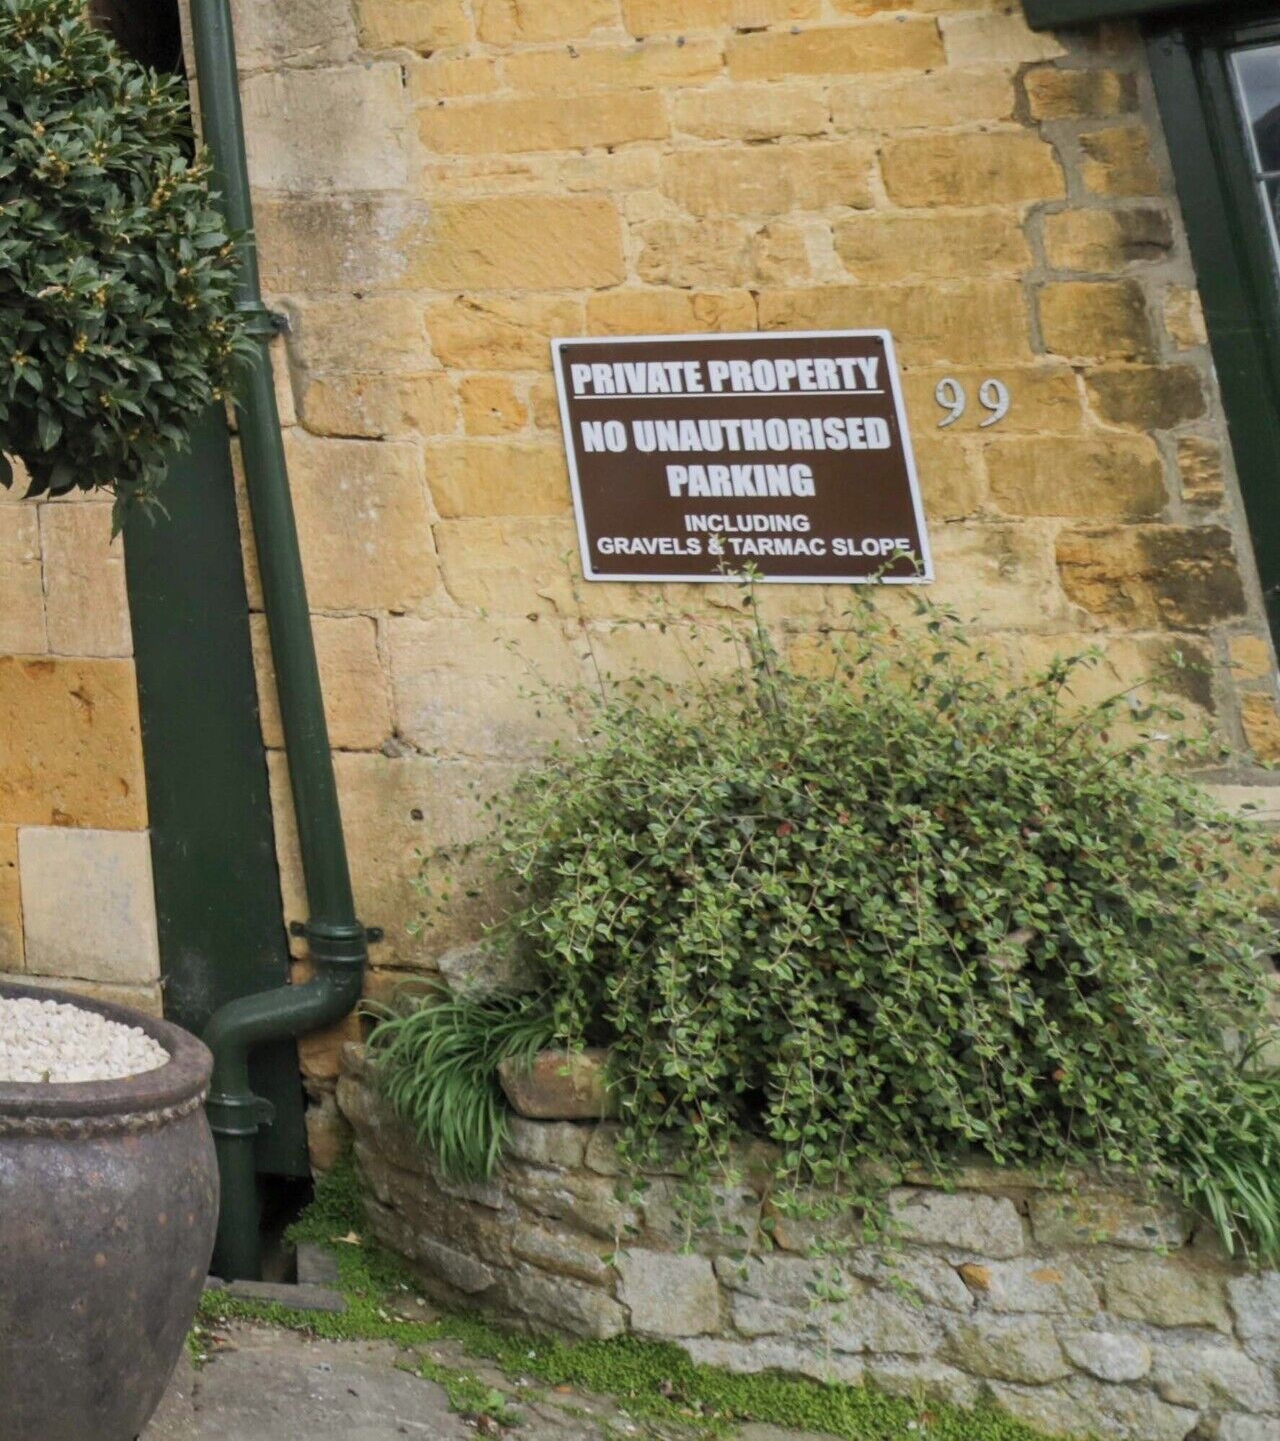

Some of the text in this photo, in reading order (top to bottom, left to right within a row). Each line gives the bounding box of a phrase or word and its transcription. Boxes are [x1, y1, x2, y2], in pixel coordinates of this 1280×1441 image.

[570, 356, 880, 395] PRIVATE PROPERTY
[935, 377, 1010, 428] 99
[580, 416, 891, 453] NO UNAUTHORISED
[665, 463, 816, 497] PARKING
[684, 514, 811, 533] INCLUDING
[596, 536, 912, 556] GRAVELS & TARMAC SLOPE
